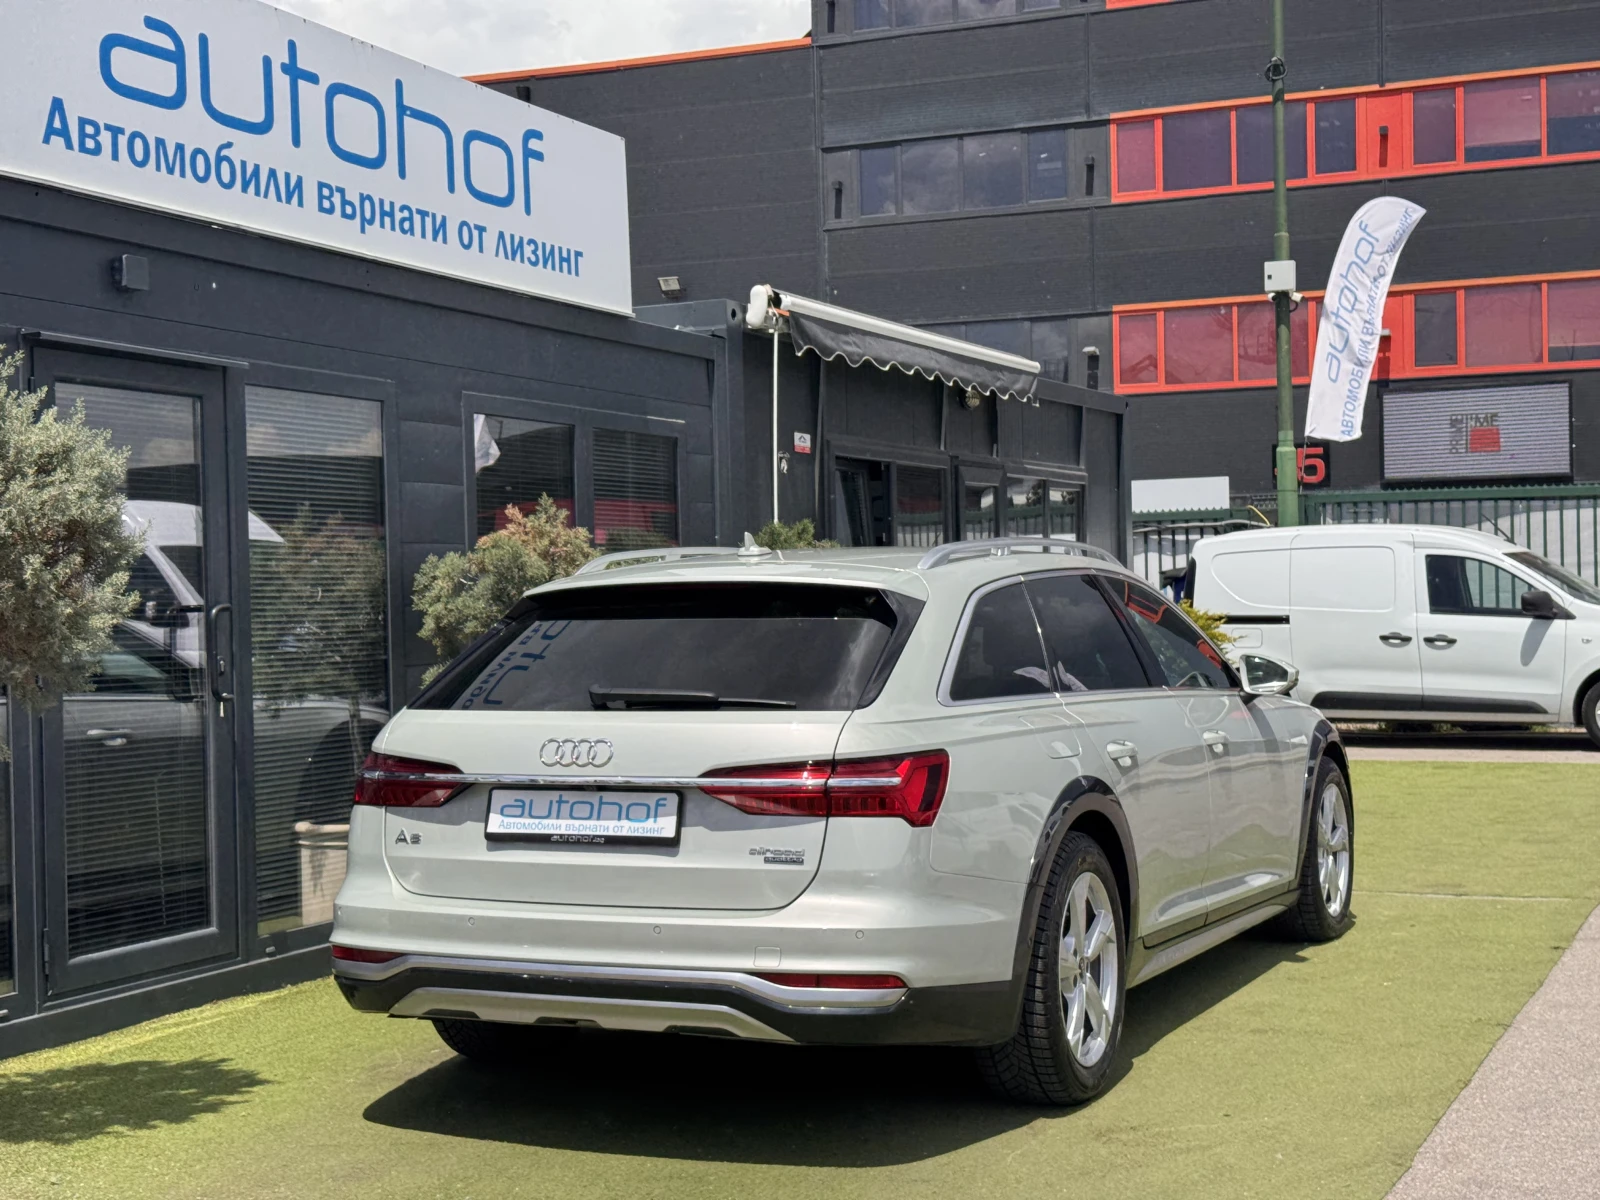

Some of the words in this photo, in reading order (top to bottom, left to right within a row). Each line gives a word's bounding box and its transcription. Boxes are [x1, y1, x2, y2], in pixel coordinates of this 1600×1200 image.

[42, 96, 303, 208] Автомобили
[317, 180, 448, 245] върнати
[457, 219, 488, 252] от
[495, 230, 584, 277] лизинг
[99, 15, 545, 216] autohof
[1326, 220, 1380, 383] autohof
[498, 818, 562, 832] Автомобили
[565, 823, 609, 834] върнати
[612, 825, 624, 833] от
[627, 826, 666, 836] лизинг
[499, 793, 668, 824] autohof
